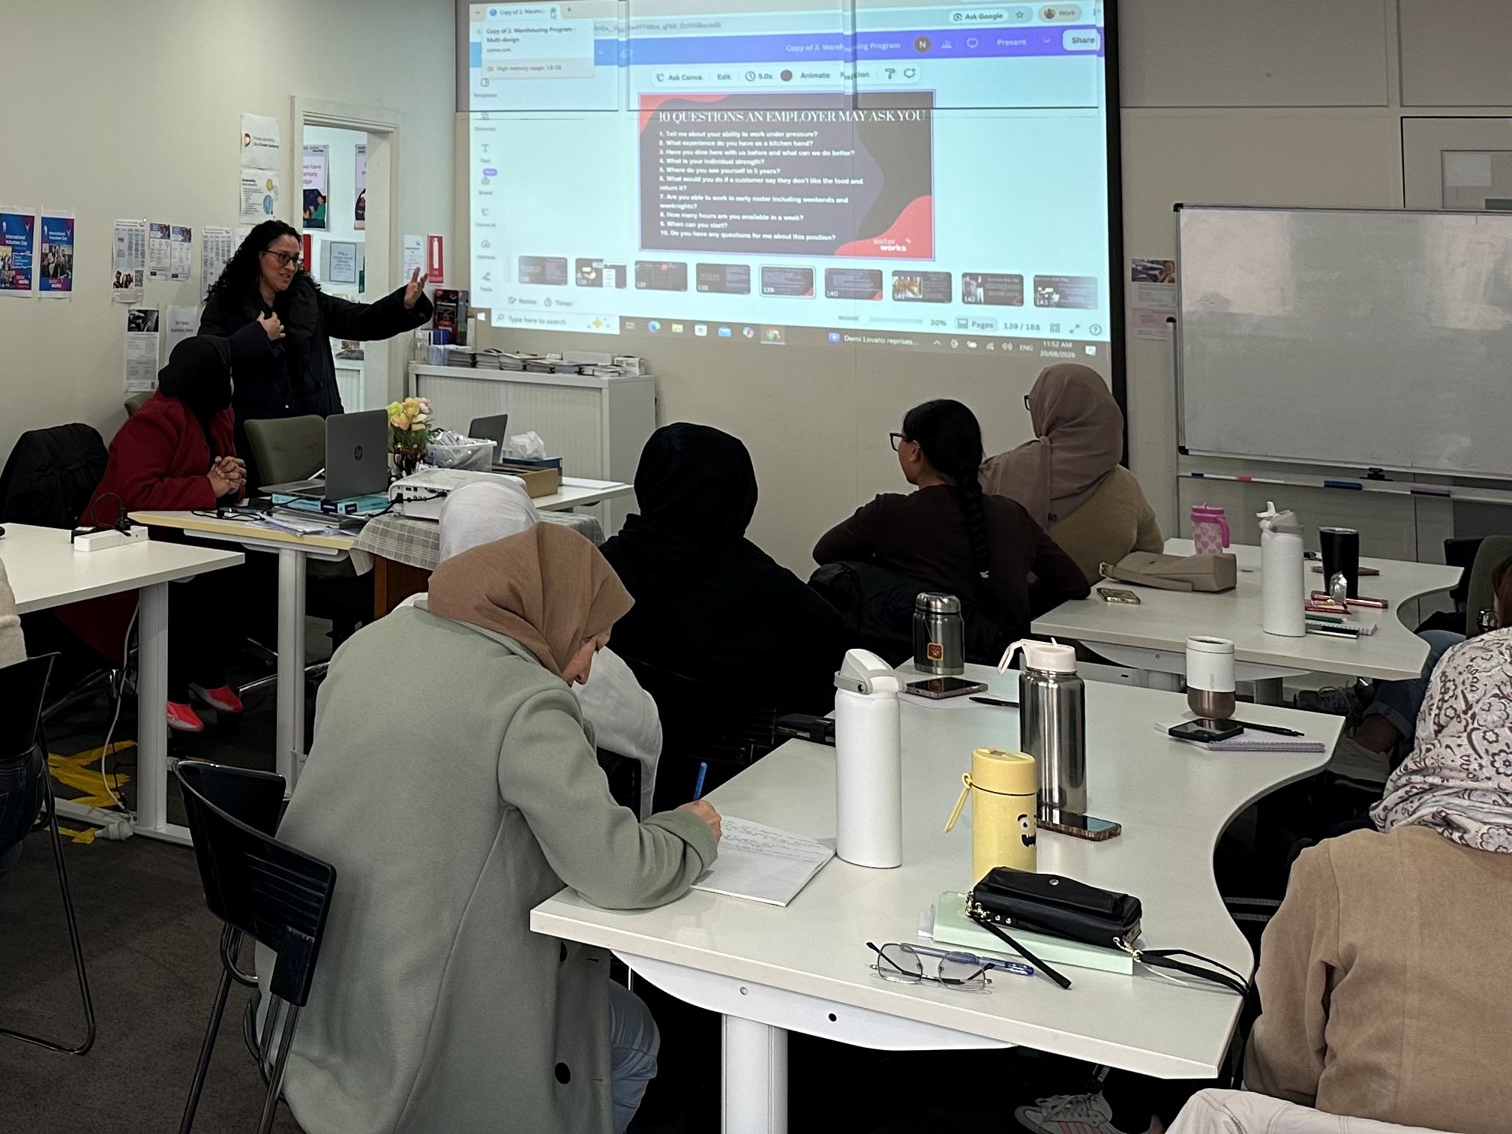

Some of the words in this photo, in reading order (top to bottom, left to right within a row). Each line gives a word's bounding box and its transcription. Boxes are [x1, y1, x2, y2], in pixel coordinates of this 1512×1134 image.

[786, 45, 804, 53] Copy
[869, 42, 900, 50] Program
[717, 73, 731, 81] Edit
[659, 111, 670, 122] 10
[673, 112, 744, 124] QUESTIONS
[747, 111, 764, 122] AN
[766, 111, 836, 122] EMPLOYER
[838, 111, 867, 122] MAY
[868, 111, 895, 122] ASK
[897, 110, 926, 121] YOU
[722, 131, 740, 139] ability
[785, 131, 818, 139] pressure?
[971, 321, 994, 329] Pages
[1003, 322, 1019, 330] 139
[863, 336, 886, 344] Lovato
